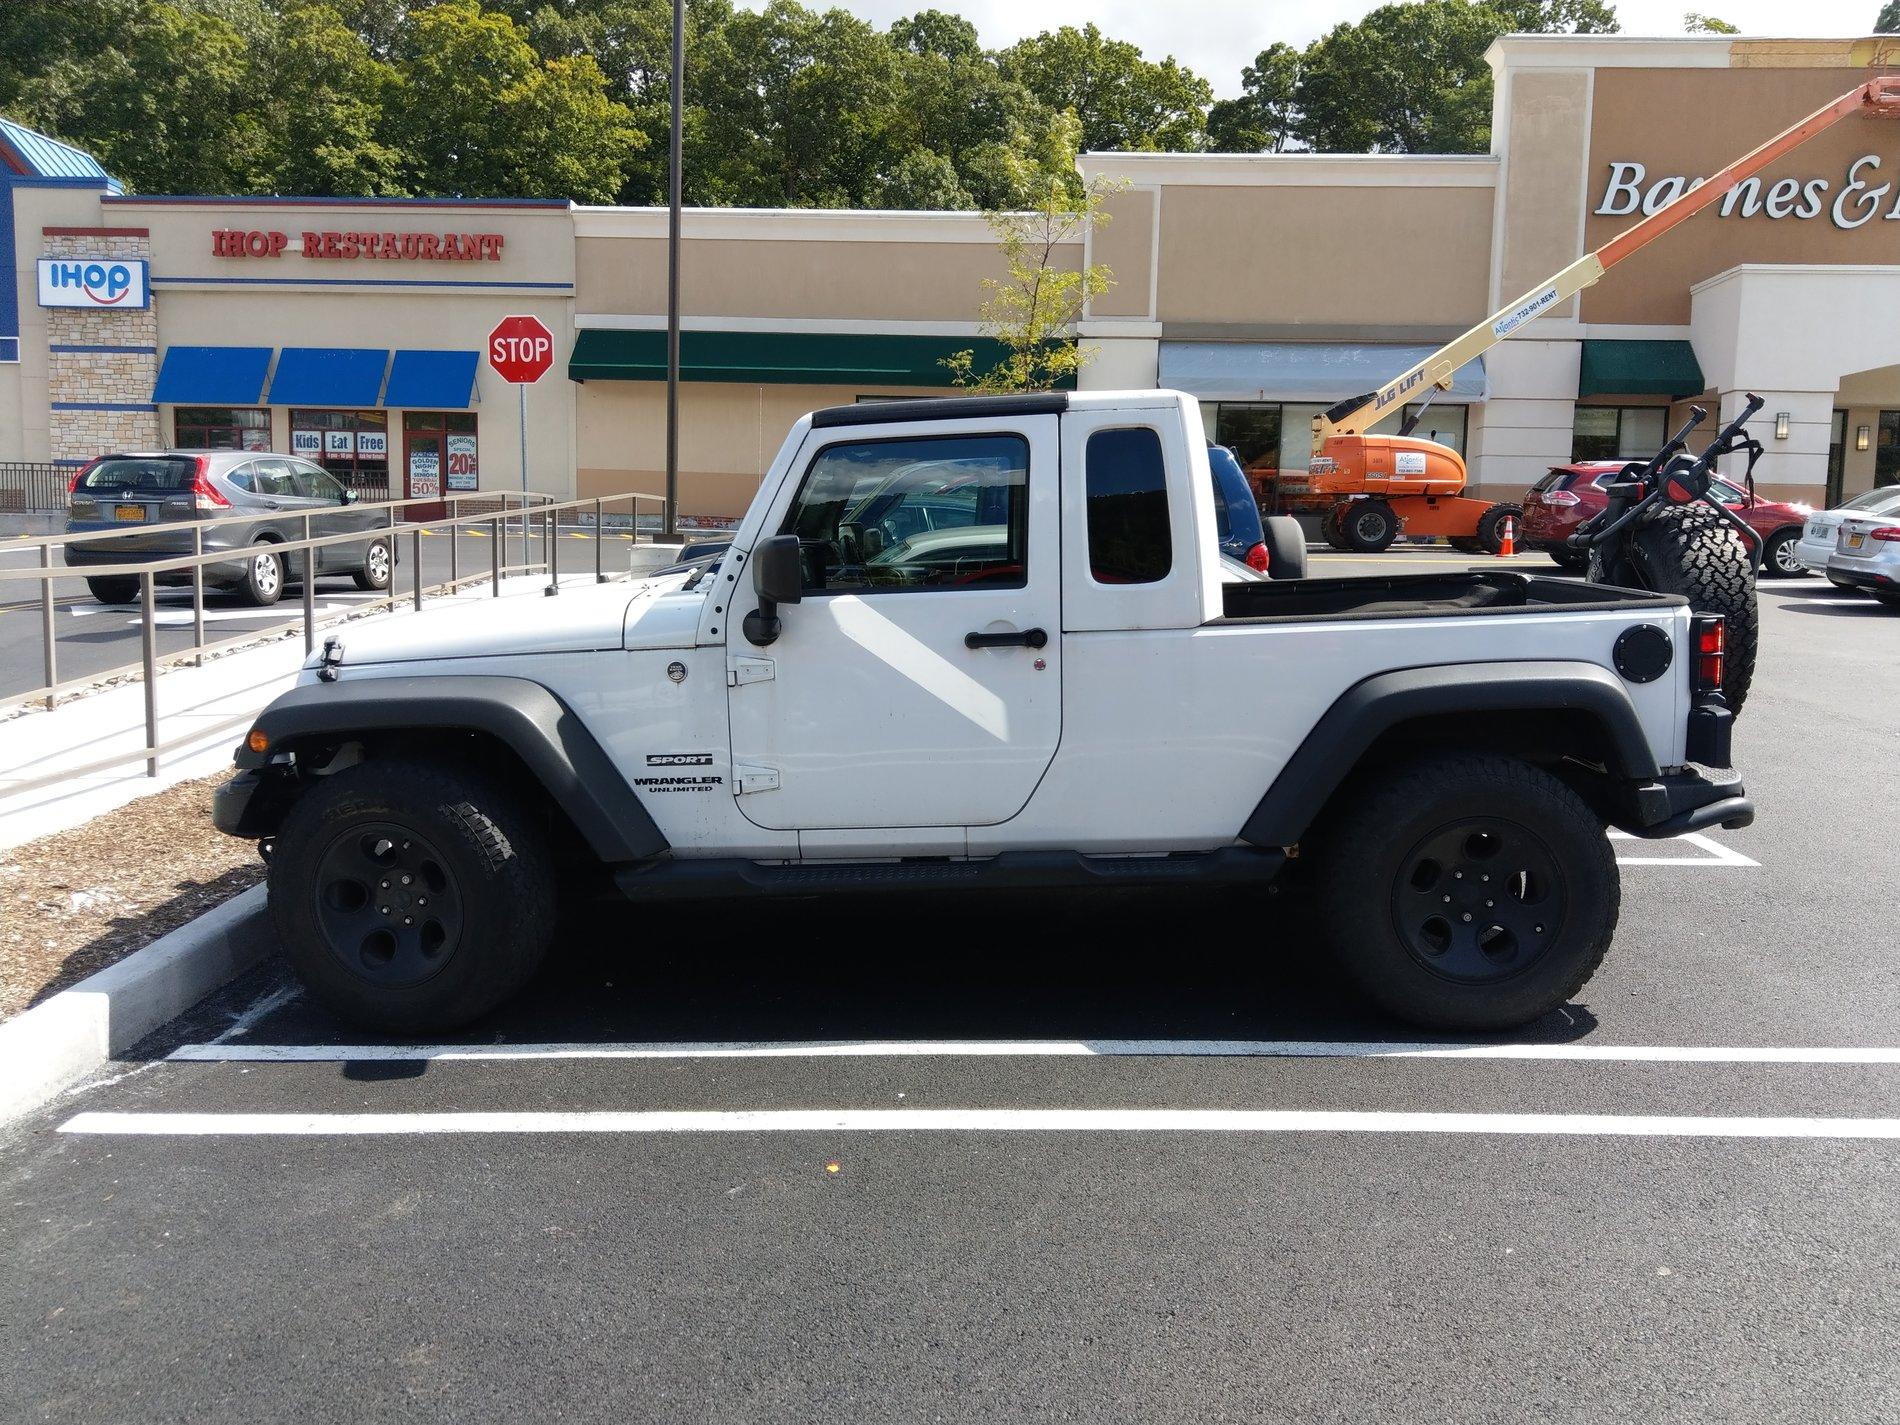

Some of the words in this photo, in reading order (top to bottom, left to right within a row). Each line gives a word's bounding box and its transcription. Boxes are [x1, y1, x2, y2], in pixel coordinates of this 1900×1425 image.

[1594, 162, 1829, 219] Banes
[1831, 154, 1891, 229] &
[211, 230, 288, 259] IHOP
[302, 231, 504, 261] RESTAURANT
[51, 263, 130, 298] IHOP
[1517, 290, 1557, 319] 732-901-RENT
[493, 337, 549, 363] STOP
[1375, 388, 1396, 410] JLG
[1399, 368, 1424, 394] LIFT
[295, 434, 319, 449] Kids
[331, 435, 348, 449] Eat
[360, 436, 384, 450] Free
[448, 437, 475, 447] SENIORS
[412, 482, 438, 494] 50%
[650, 755, 713, 765] SPORT
[634, 776, 723, 786] WRANGLER
